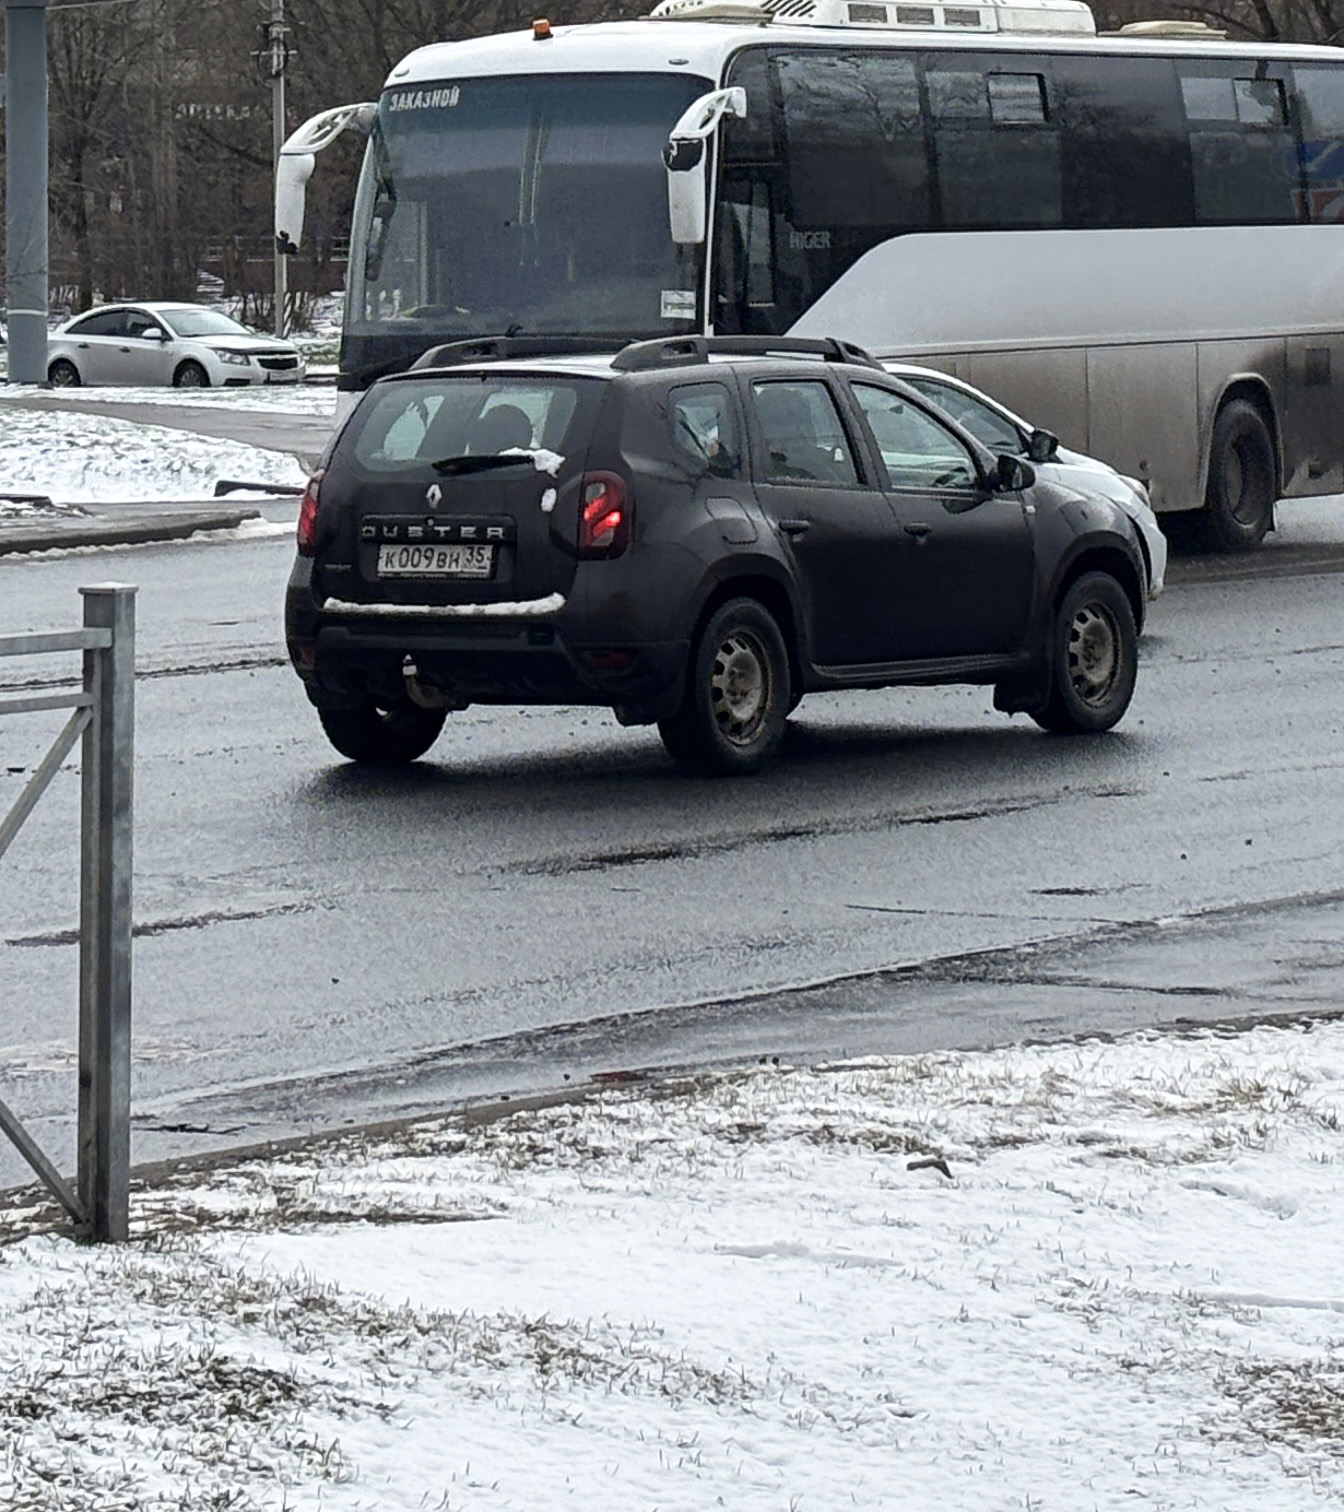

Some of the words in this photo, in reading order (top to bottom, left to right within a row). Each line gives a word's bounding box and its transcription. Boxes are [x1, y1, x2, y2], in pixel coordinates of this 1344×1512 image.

[389, 85, 460, 112] ЗАКАЗНОЙ
[362, 525, 504, 539] DUSTER
[465, 546, 485, 564] 35
